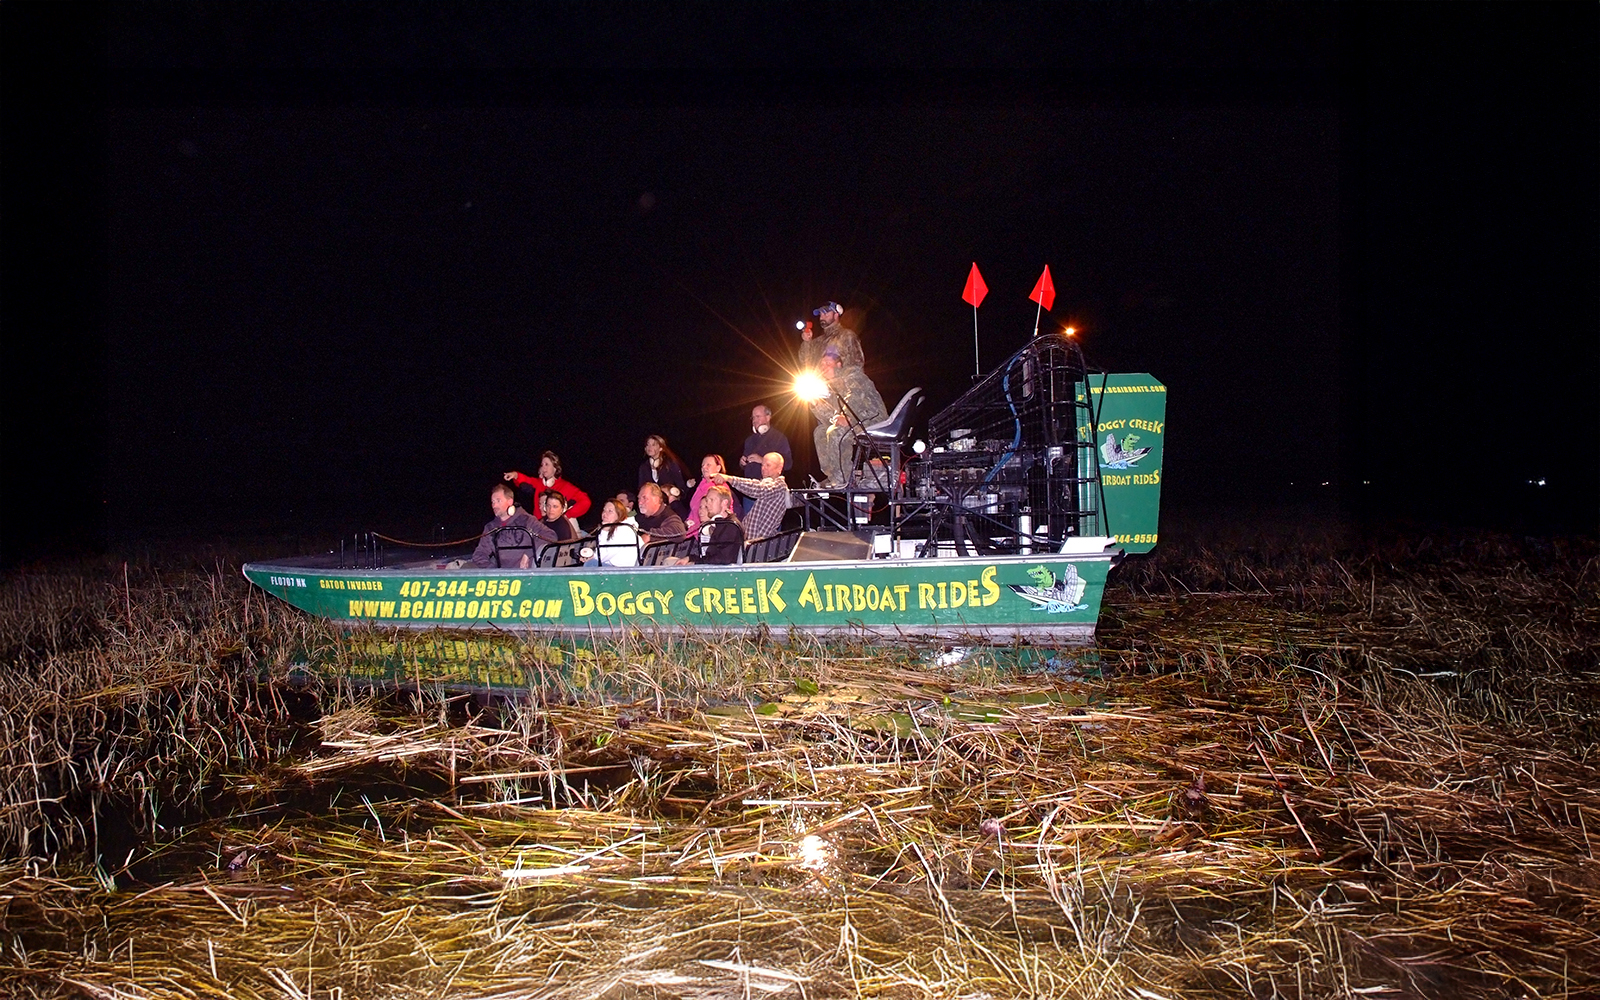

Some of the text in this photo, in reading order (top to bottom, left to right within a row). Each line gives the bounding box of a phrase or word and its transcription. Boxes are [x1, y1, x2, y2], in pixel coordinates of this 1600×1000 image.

[1129, 418, 1164, 434] CREEK
[1102, 469, 1160, 486] IRBOAT RIDES
[1113, 534, 1158, 544] 344-9550
[319, 579, 383, 591] GATOR INVADER
[399, 579, 522, 598] 407-344-9550
[568, 565, 1001, 617] BOGGY CREEK AIRBOAT RIDES
[349, 599, 564, 619] WWW.BCAIRBOATS.COM
